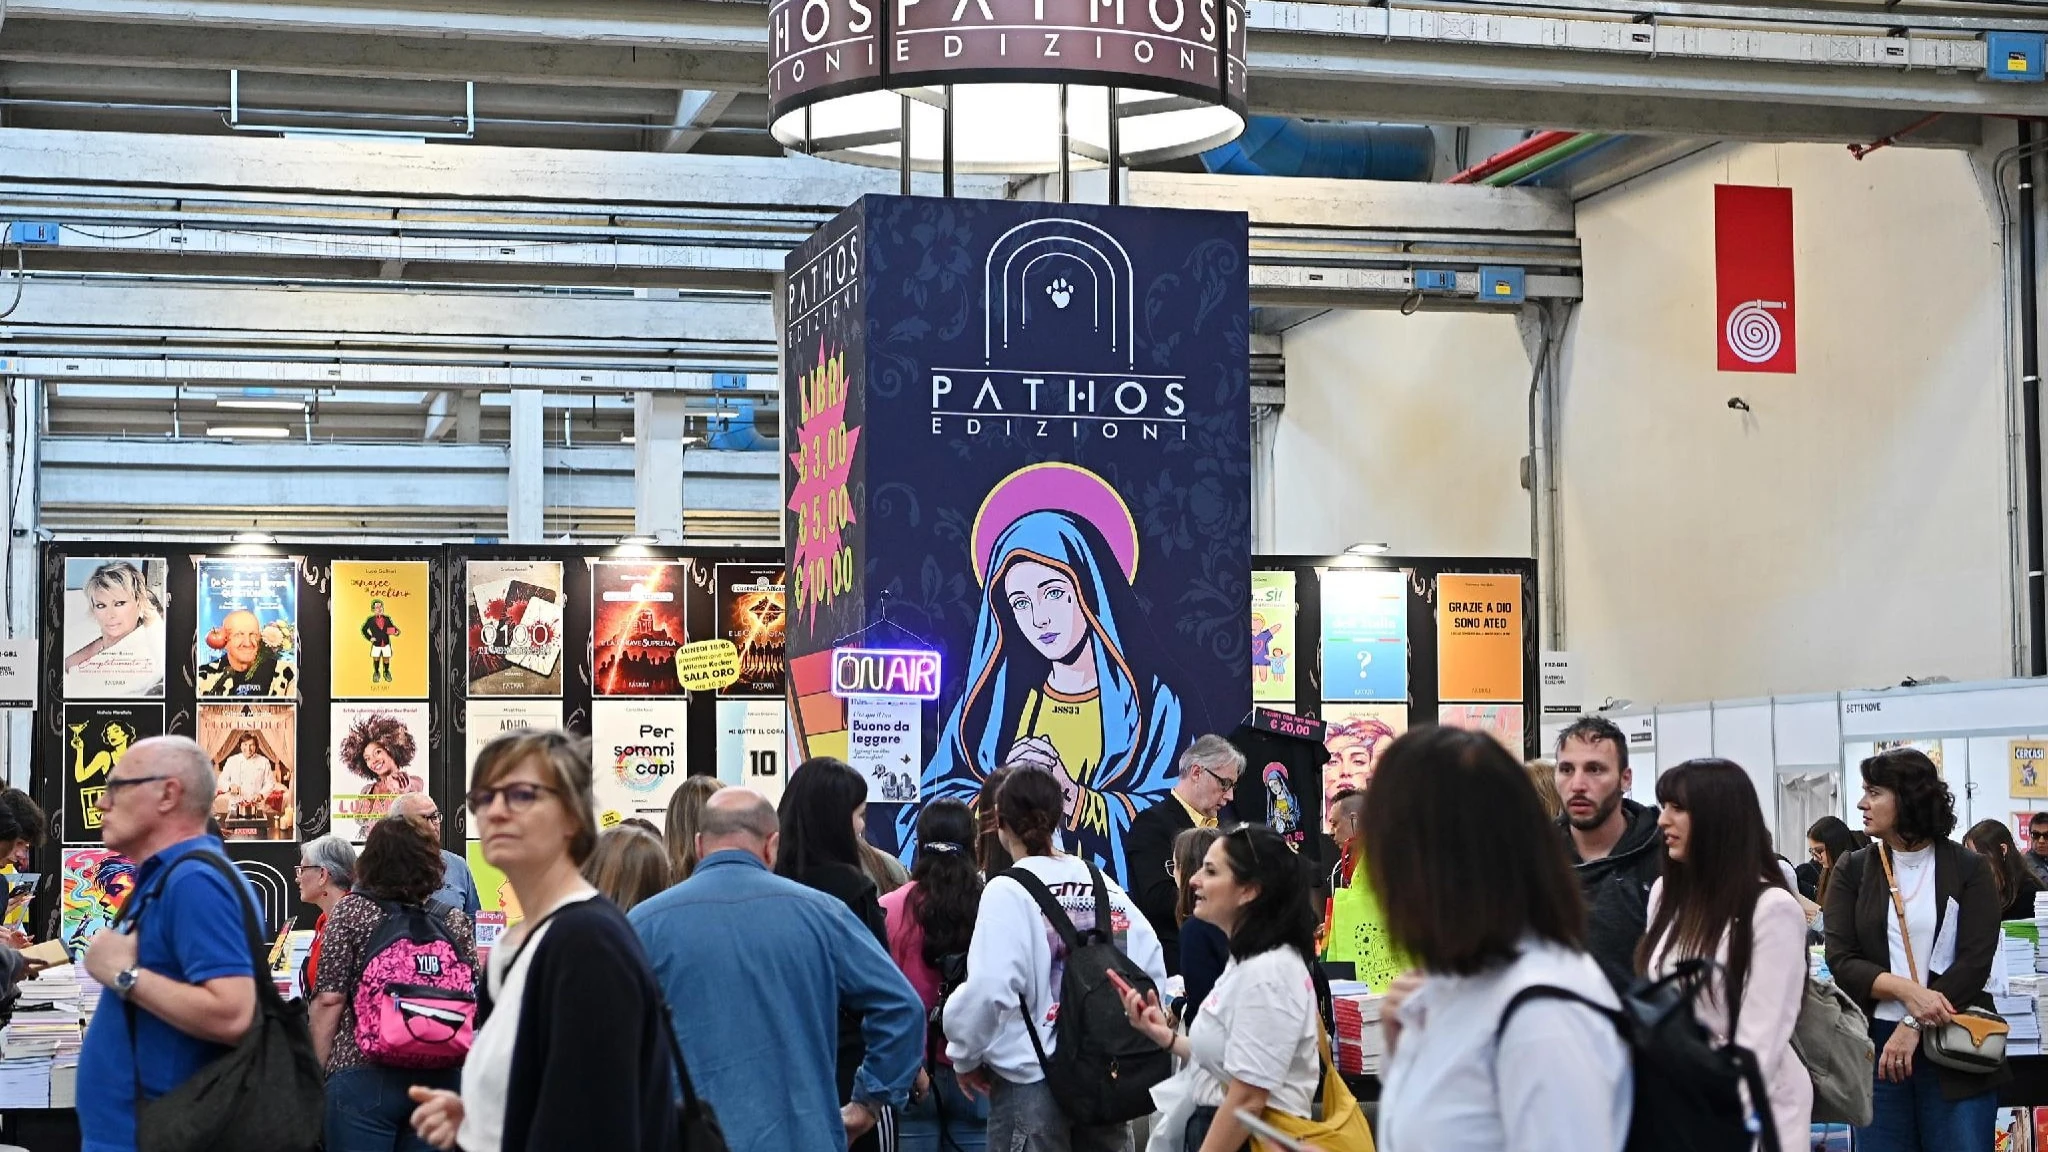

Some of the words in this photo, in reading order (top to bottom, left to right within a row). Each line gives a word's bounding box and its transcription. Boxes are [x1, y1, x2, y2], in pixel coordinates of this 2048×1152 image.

[768, 0, 872, 58] HOS
[769, 43, 873, 98] IONI
[897, 34, 1218, 78] EDIZIONI
[788, 235, 858, 321] PATHOS
[788, 284, 858, 349] EDIZIONI
[800, 352, 844, 425] LIBRI
[931, 375, 1185, 416] PATHOS
[931, 418, 1186, 440] EDIZIONI
[813, 421, 847, 480] 3,00
[813, 483, 848, 544] 5,00
[809, 546, 853, 605] 10,00
[1449, 602, 1483, 613] GRAZIE
[1486, 602, 1494, 613] A
[1496, 602, 1512, 613] DIO
[1454, 618, 1480, 628] SONO
[1484, 618, 1507, 628] ATEO
[642, 639, 677, 648] SUPREMA
[684, 671, 709, 682] SALA
[712, 667, 735, 679] ORO
[838, 656, 884, 690] ON
[886, 657, 935, 692] AIR
[1846, 702, 1882, 713] SETTENOVE
[640, 724, 674, 738] Per
[853, 720, 891, 731] Buono
[893, 720, 910, 731] da
[1270, 719, 1278, 729] €
[1280, 721, 1310, 735] 20,00
[853, 732, 901, 747] leggere
[614, 742, 674, 757] sommi
[2015, 747, 2045, 759] CERCASI
[636, 760, 675, 776] capi
[750, 750, 777, 776] 10
[417, 955, 438, 972] YUB
